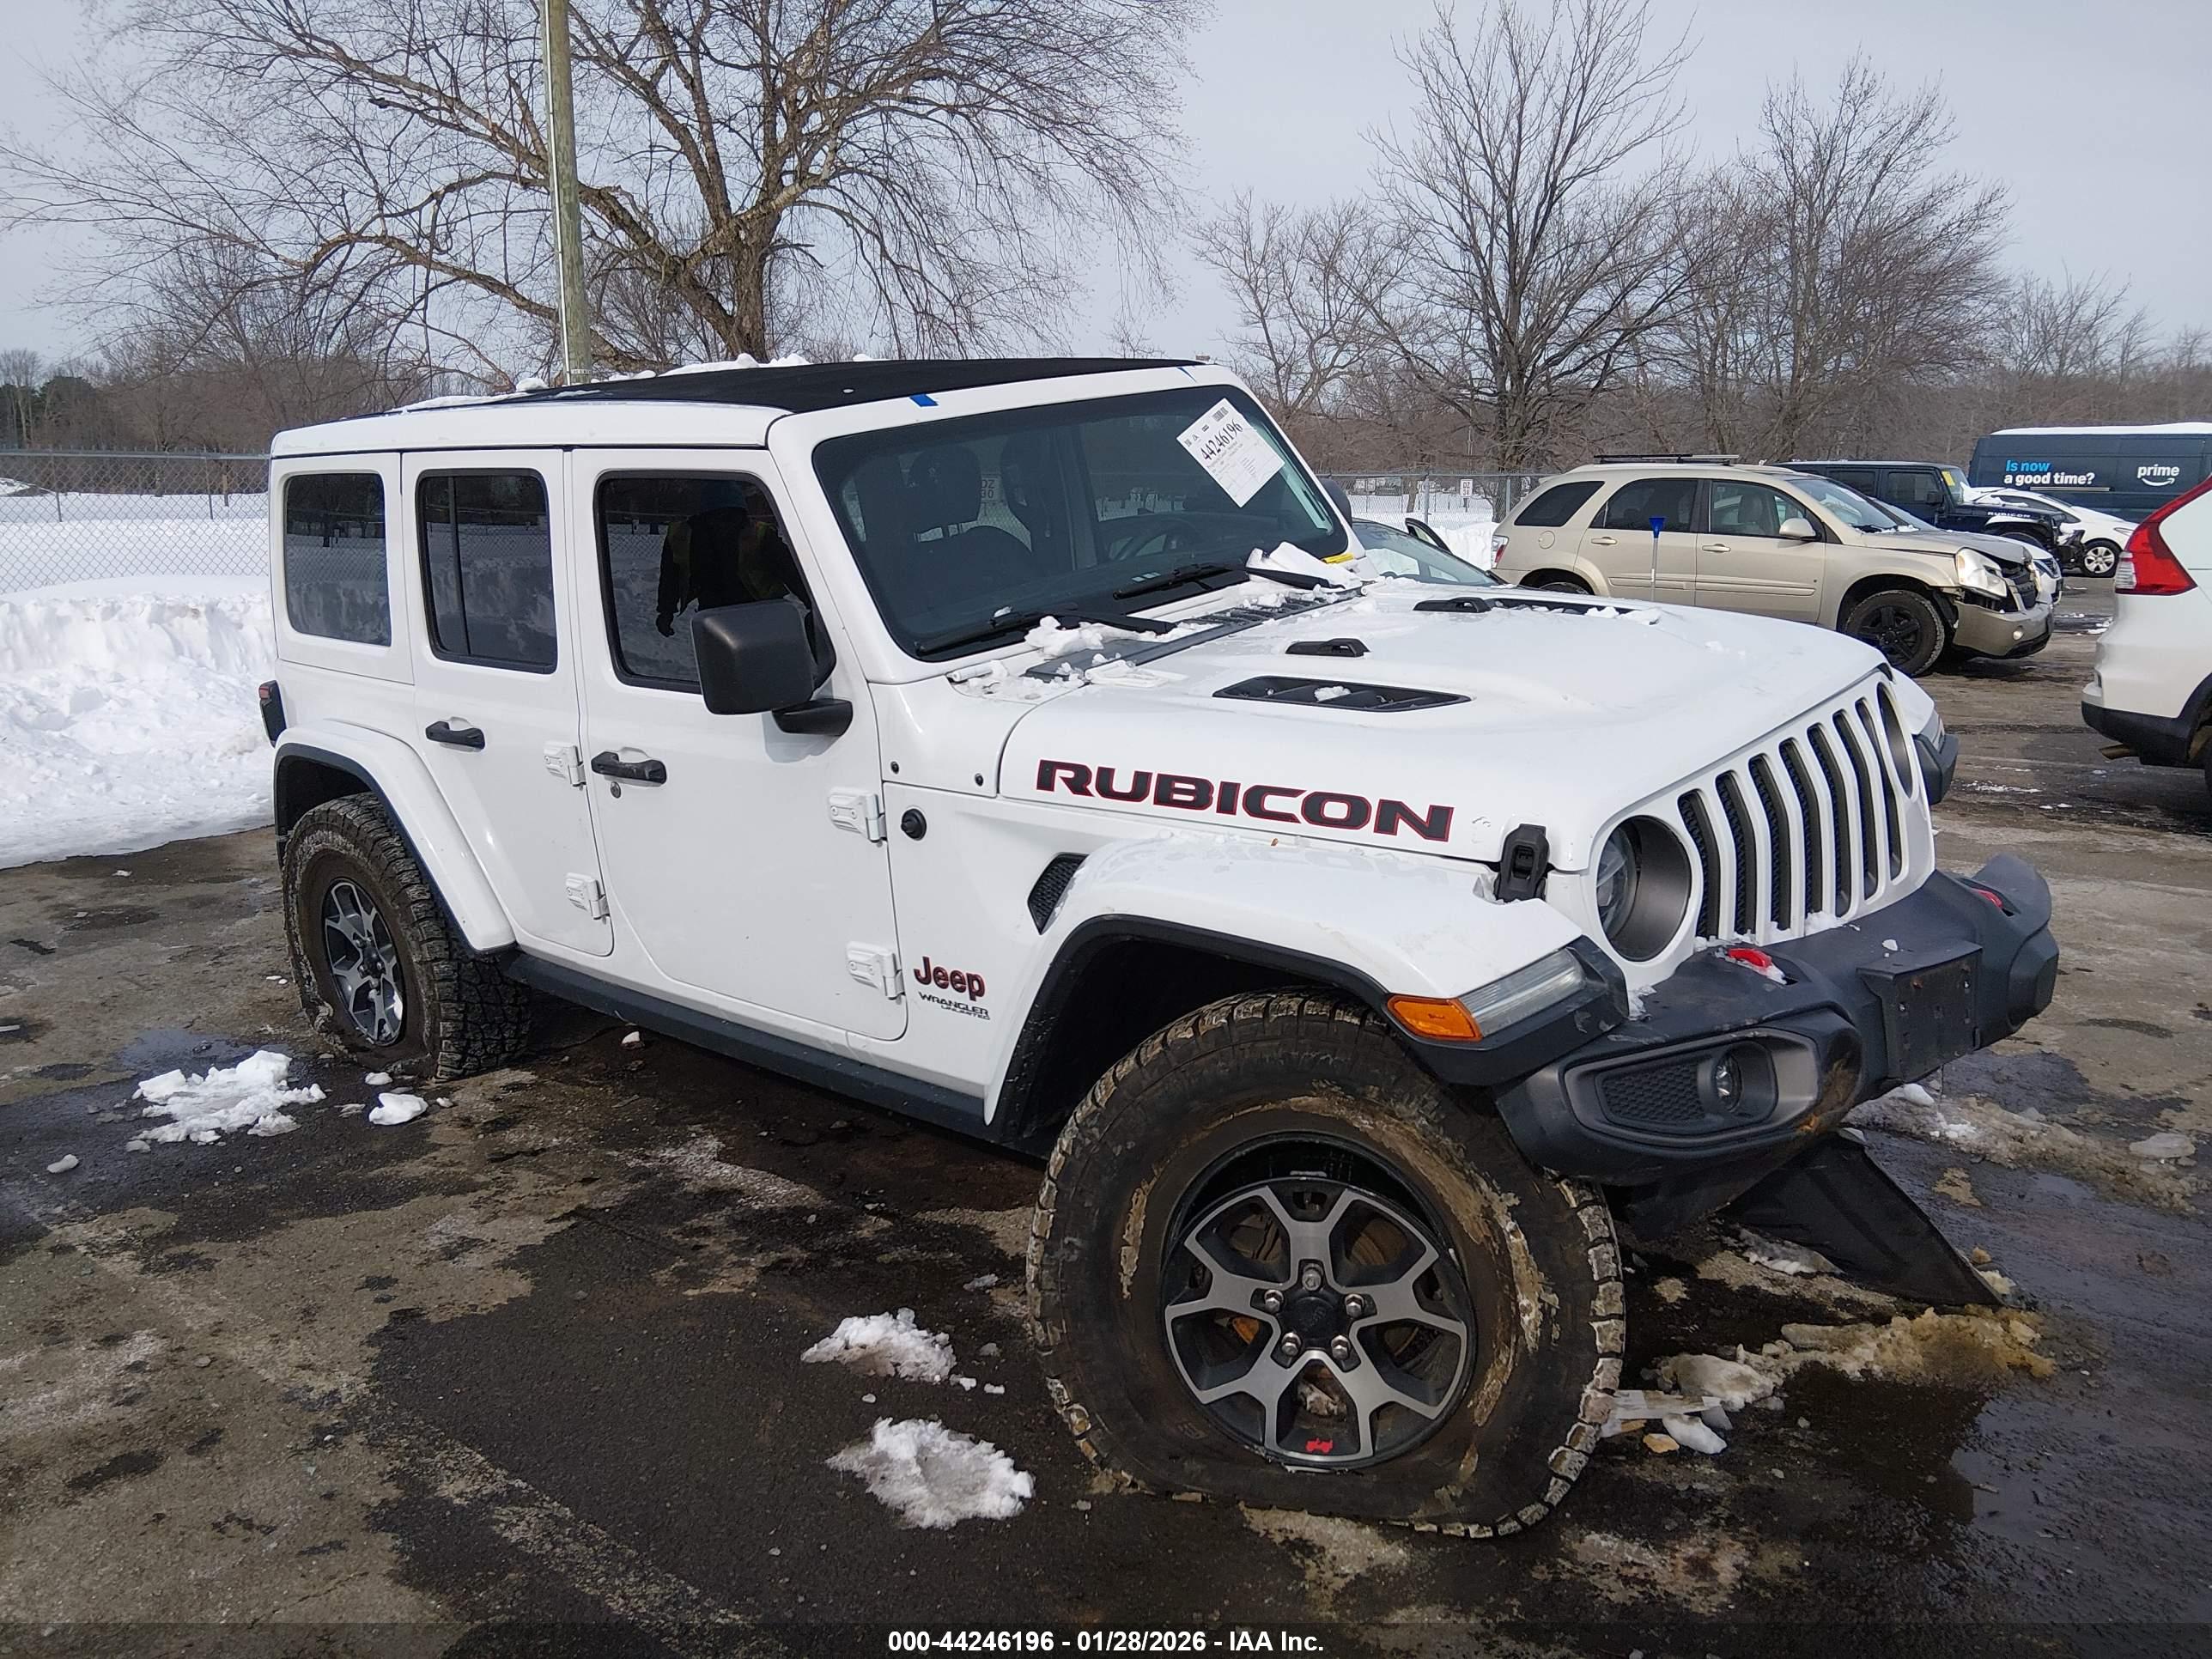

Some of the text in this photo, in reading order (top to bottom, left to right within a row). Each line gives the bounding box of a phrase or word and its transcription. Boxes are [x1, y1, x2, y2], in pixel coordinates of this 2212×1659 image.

[1200, 418, 1243, 461] 44246196
[2006, 460, 2051, 471] Is now
[2137, 465, 2179, 478] prime
[2004, 472, 2095, 486] a good time?
[1035, 758, 1456, 844] RUBICON
[914, 957, 985, 1002] Jeep
[918, 991, 990, 1016] WRANGLER
